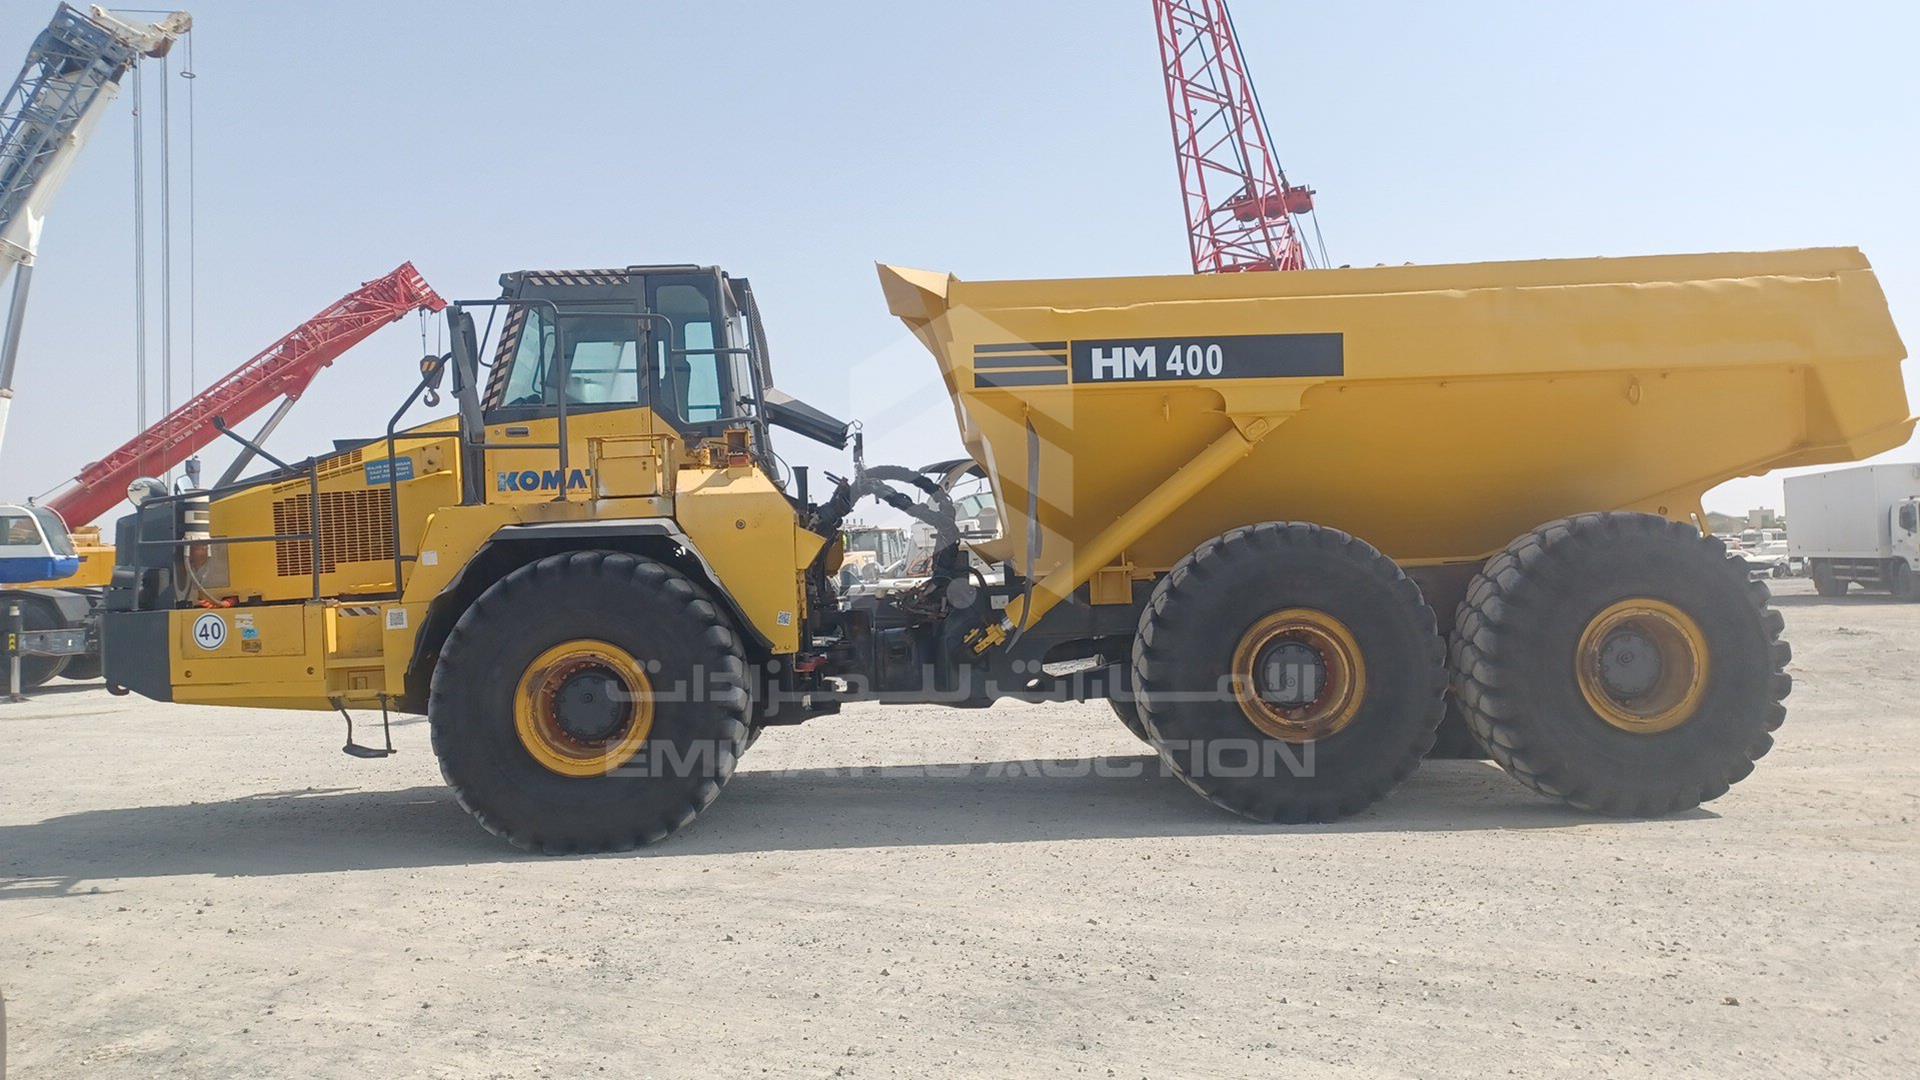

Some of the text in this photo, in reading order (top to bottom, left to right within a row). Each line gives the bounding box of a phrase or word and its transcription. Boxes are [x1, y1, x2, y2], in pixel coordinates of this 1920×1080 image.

[1091, 344, 1223, 379] HM 400
[198, 623, 221, 640] 40
